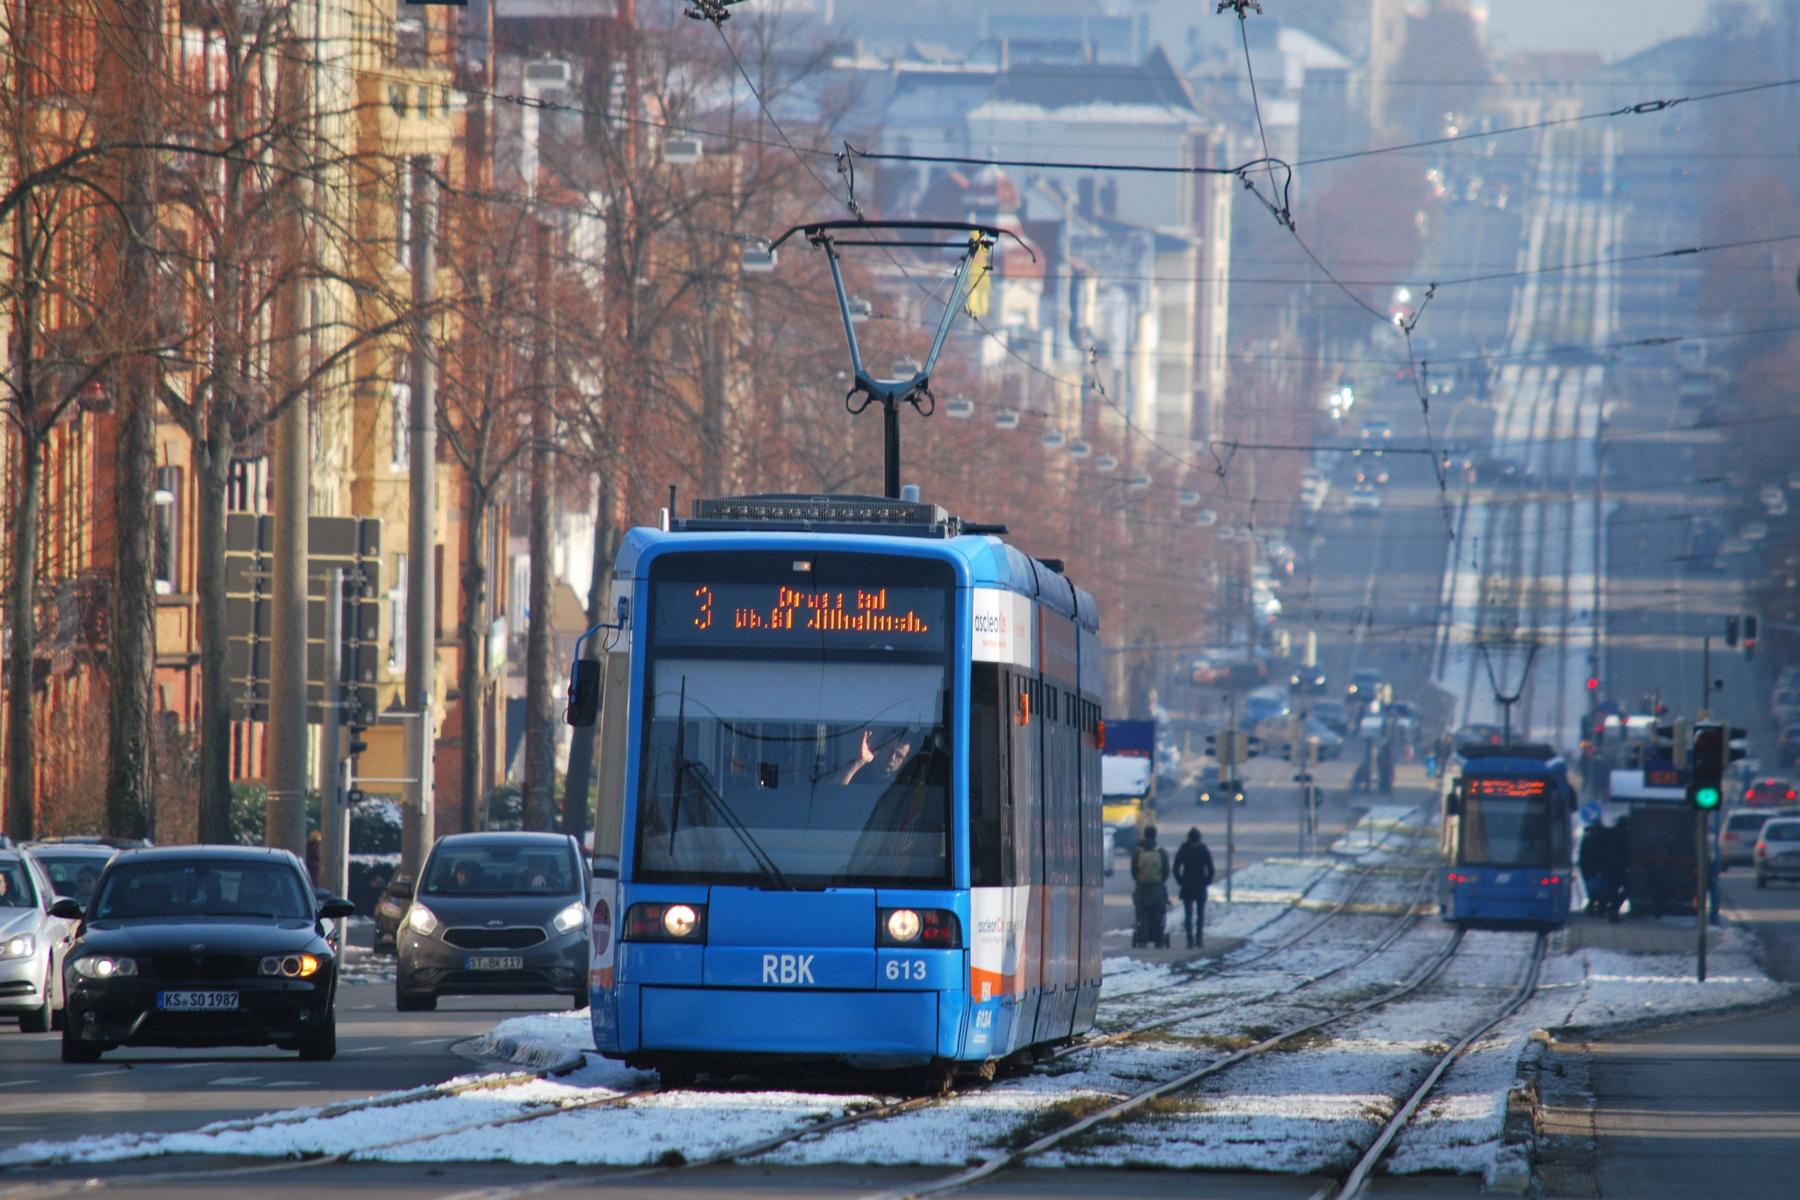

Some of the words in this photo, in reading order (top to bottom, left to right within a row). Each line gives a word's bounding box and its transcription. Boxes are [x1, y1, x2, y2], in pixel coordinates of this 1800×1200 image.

[695, 586, 714, 630] 3
[762, 954, 815, 984] RBK
[885, 960, 927, 981] 613
[165, 993, 181, 1007] KS
[207, 993, 238, 1007] 1987
